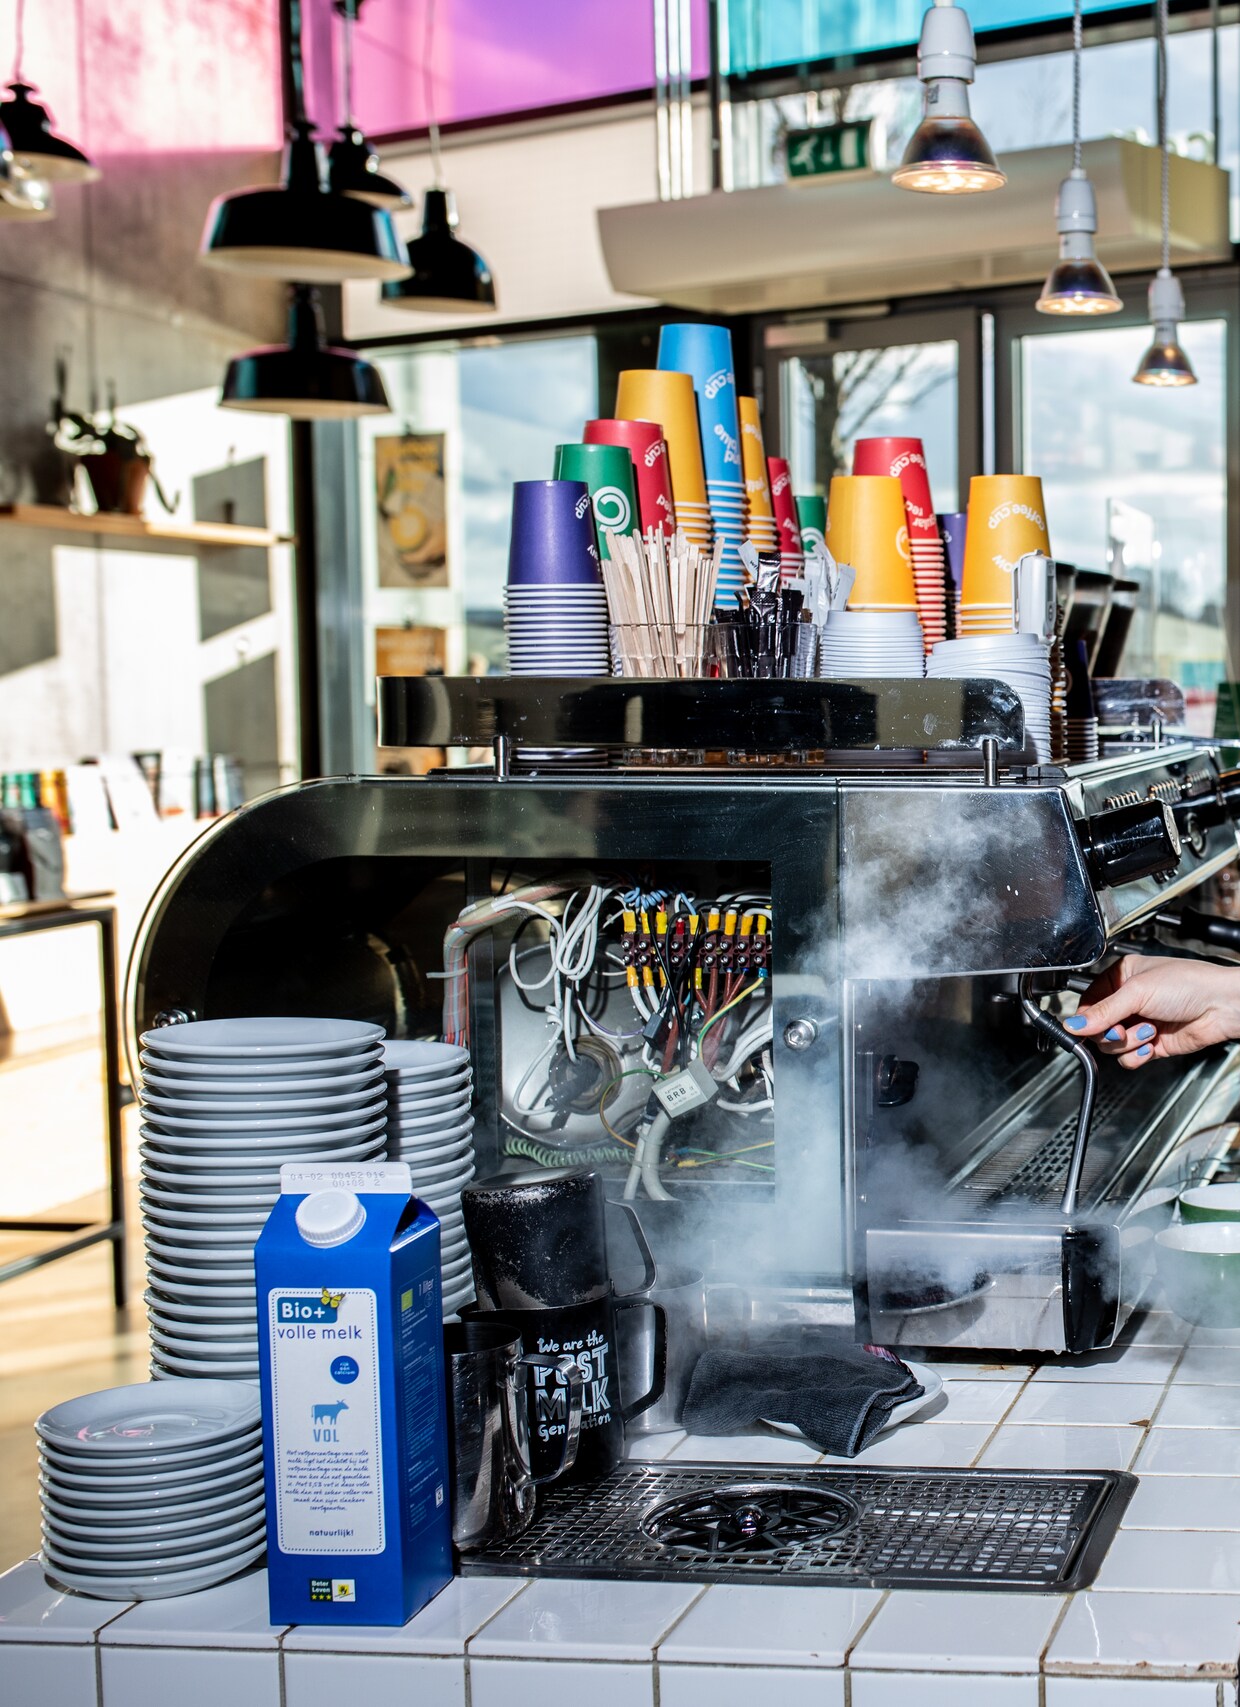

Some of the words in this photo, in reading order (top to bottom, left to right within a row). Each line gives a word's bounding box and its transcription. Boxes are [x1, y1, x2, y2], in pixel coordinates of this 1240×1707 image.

[704, 374, 727, 399] cup
[644, 446, 661, 468] cup
[889, 456, 910, 477] cup
[988, 506, 1011, 529] cup
[1012, 503, 1045, 531] coffee
[281, 1301, 326, 1319] Bio+
[277, 1324, 316, 1340] volle
[322, 1324, 362, 1340] melk
[537, 1337, 560, 1354] We
[562, 1340, 584, 1351] are
[586, 1329, 604, 1347] the
[534, 1376, 612, 1422] MLK
[313, 1429, 340, 1442] VOL
[537, 1412, 612, 1442] Genation
[309, 1529, 354, 1537] natuurlijk!
